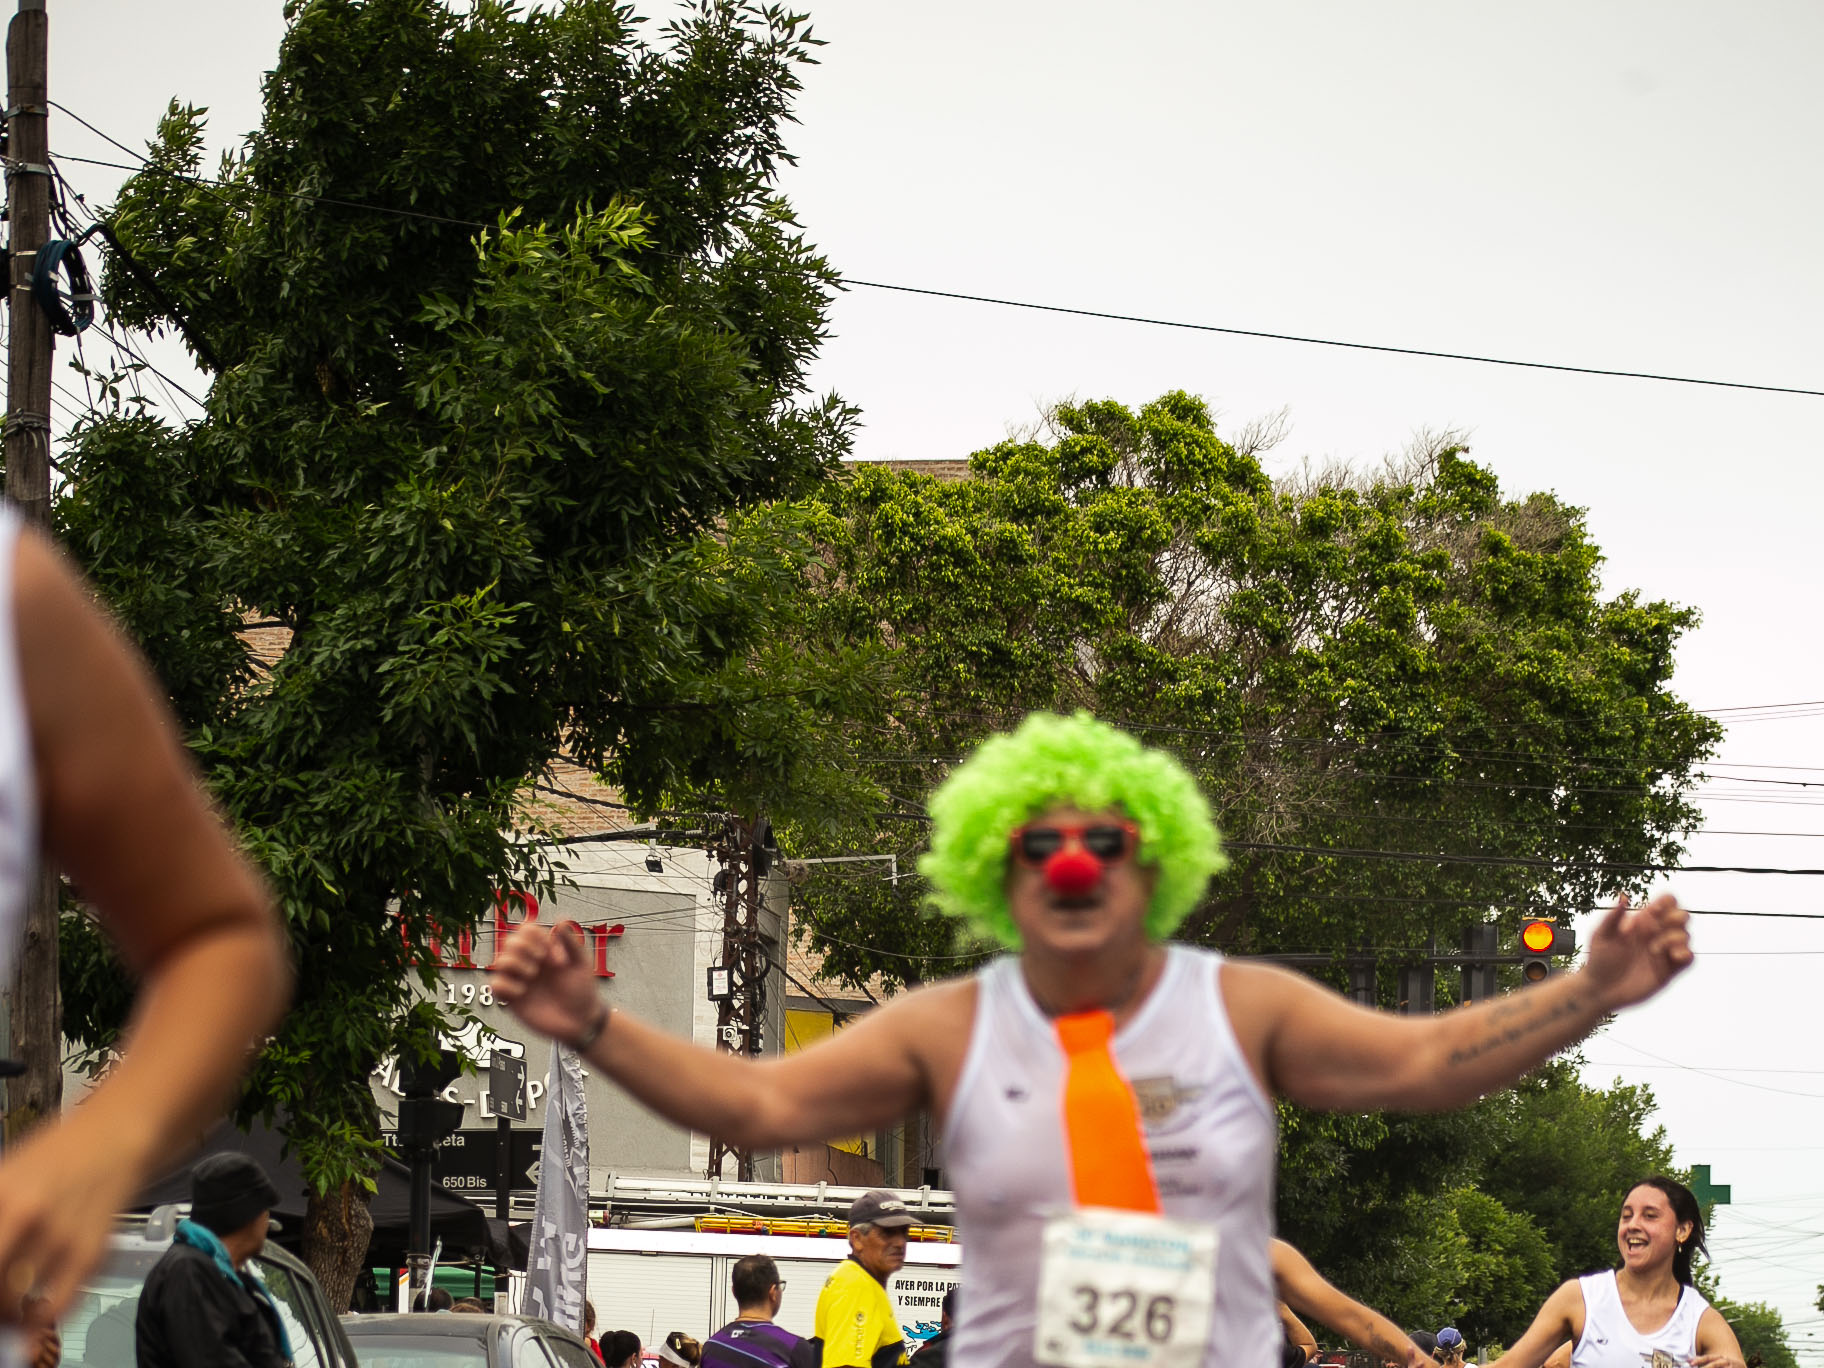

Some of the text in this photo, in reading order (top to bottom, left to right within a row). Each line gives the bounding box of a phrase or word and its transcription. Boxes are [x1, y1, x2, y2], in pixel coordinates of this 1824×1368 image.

[444, 983, 510, 1006] 198
[442, 1176, 487, 1188] 650 Bis
[894, 1279, 915, 1291] AYER
[917, 1281, 934, 1292] POR
[935, 1281, 945, 1292] LA
[898, 1295, 941, 1308] Y SIEMPRE
[1071, 1285, 1177, 1344] 326
